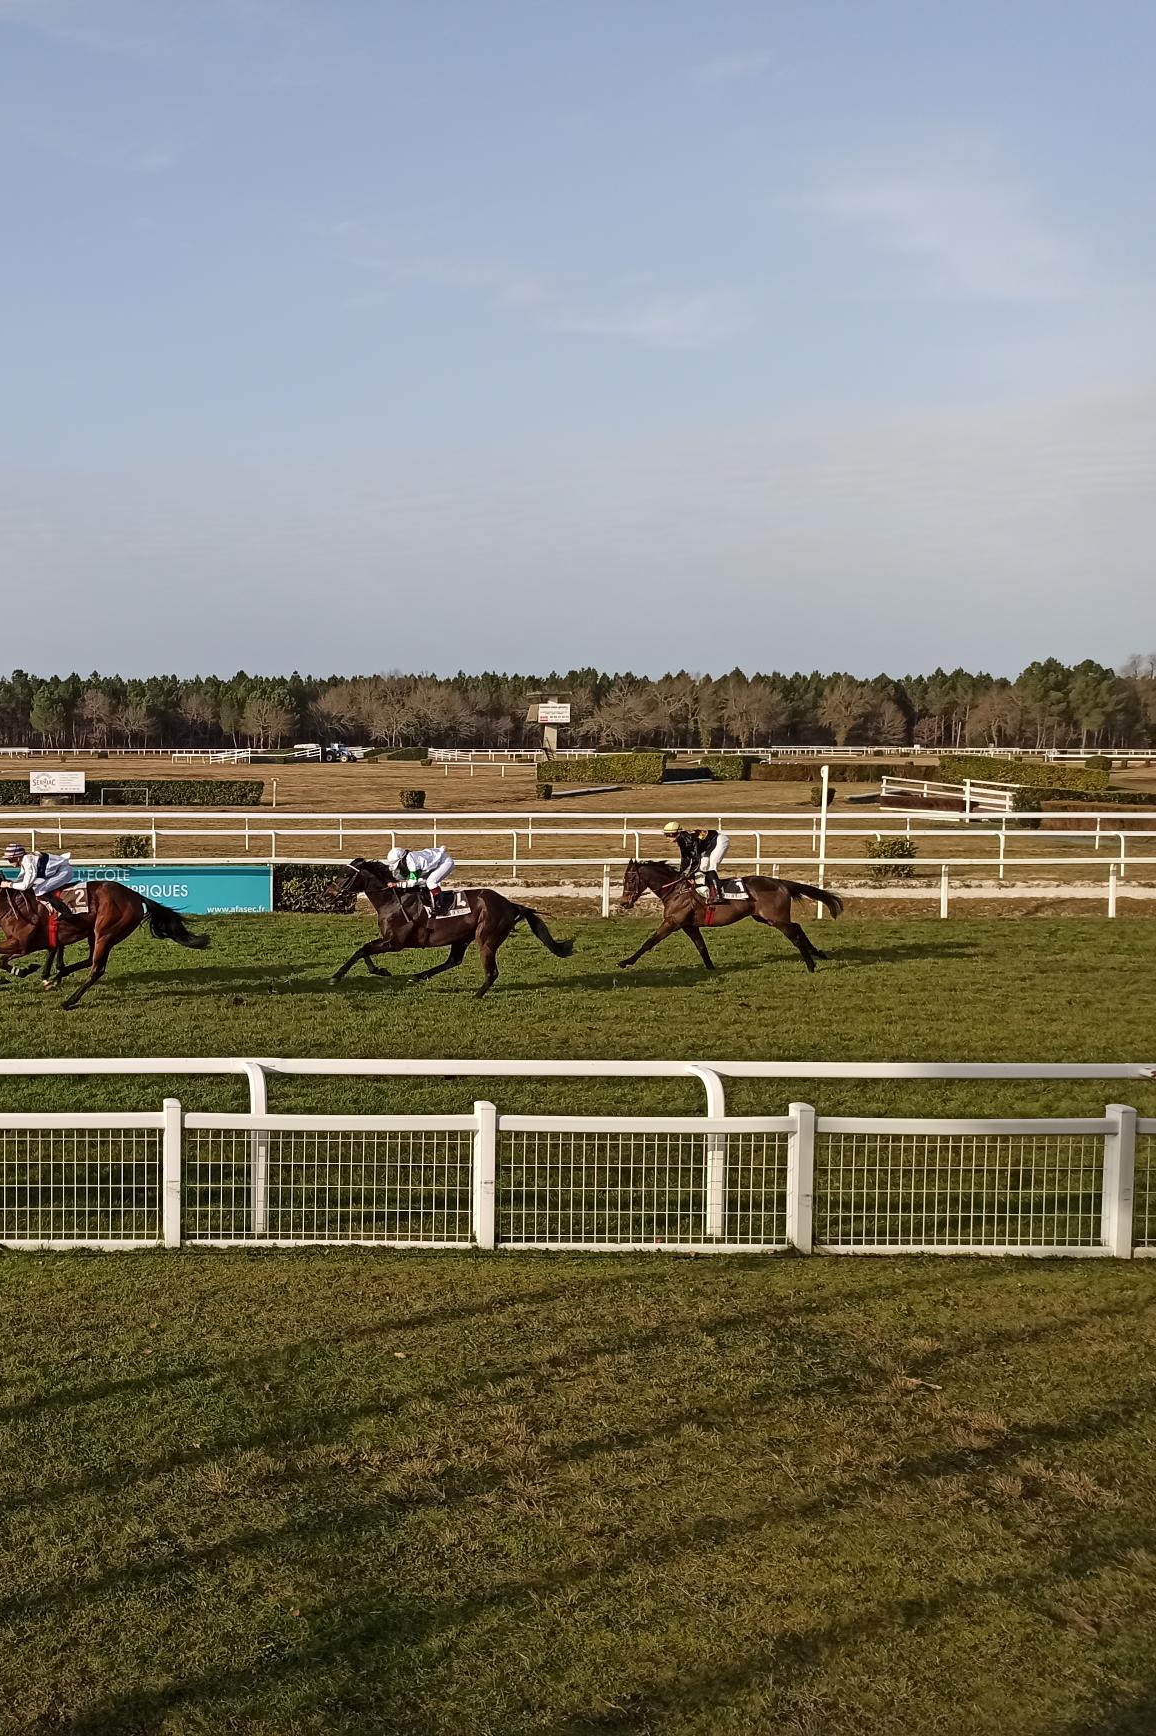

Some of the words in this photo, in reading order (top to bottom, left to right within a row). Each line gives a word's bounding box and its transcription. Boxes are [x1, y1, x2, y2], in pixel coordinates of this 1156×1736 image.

[127, 884, 188, 897] PPIQUES
[74, 889, 86, 906] 2
[206, 905, 265, 913] www.afasec.fr
